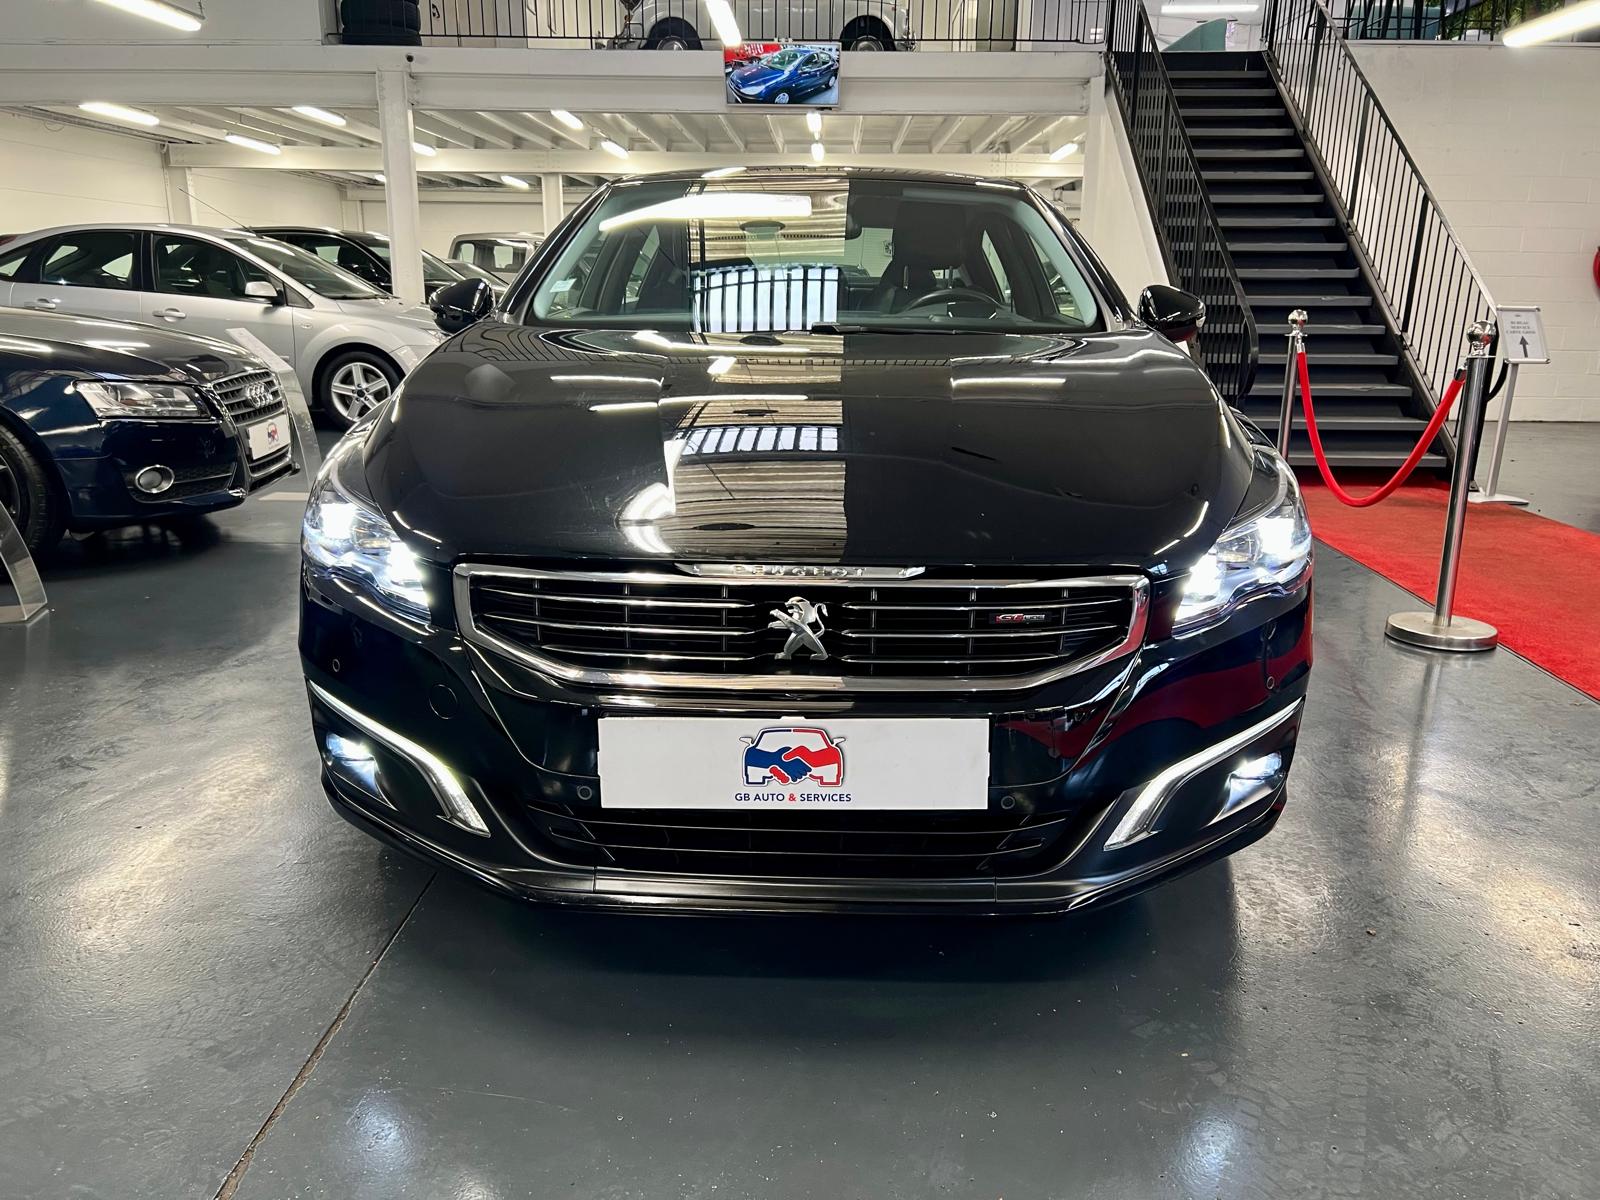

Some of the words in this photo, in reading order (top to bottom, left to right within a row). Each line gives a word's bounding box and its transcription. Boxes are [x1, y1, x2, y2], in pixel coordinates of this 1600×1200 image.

[734, 792, 751, 802] GB
[753, 792, 785, 802] AUTO
[788, 792, 797, 802] &
[799, 792, 852, 802] SERVICES
